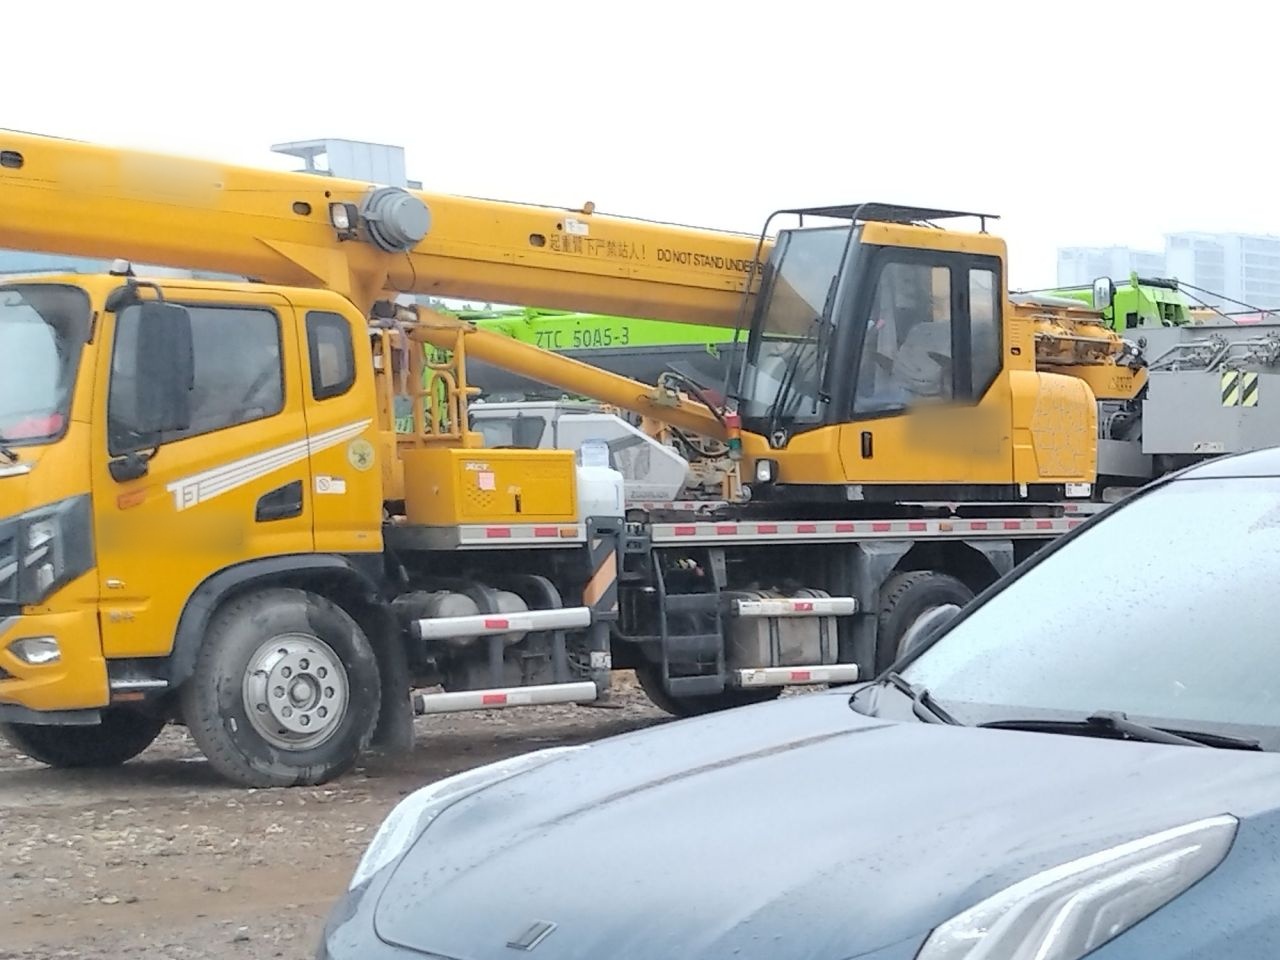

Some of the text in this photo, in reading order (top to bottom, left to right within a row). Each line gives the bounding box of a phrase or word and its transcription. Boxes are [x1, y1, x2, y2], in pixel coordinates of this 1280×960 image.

[657, 248, 672, 262] DO
[673, 250, 692, 265] NOT
[694, 253, 723, 270] STAND
[535, 330, 562, 348] ZTC
